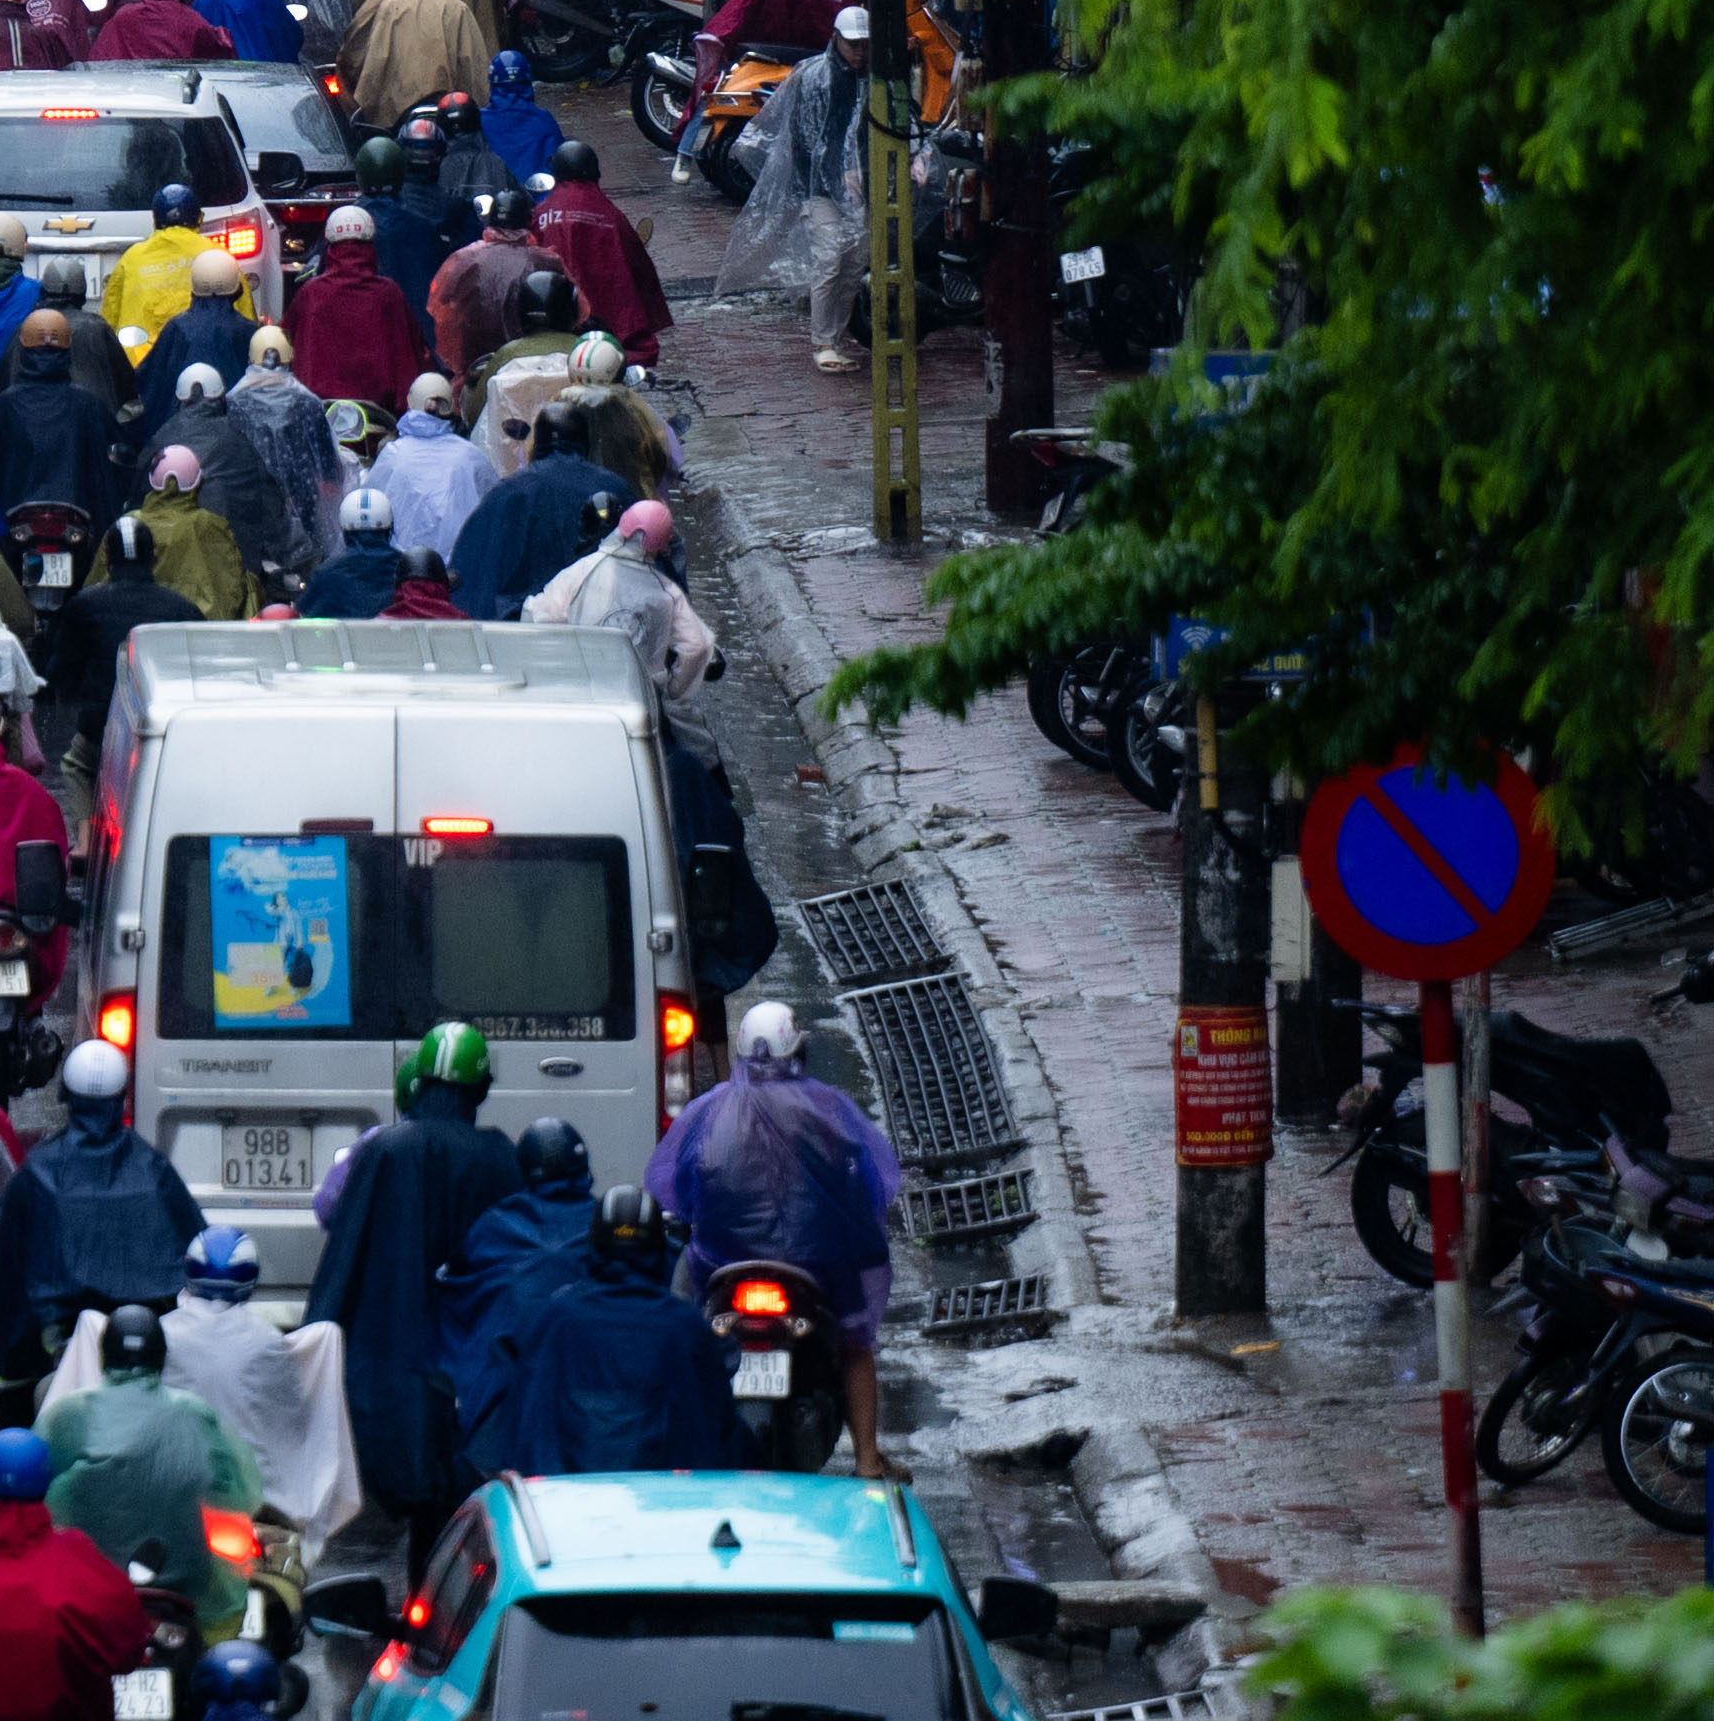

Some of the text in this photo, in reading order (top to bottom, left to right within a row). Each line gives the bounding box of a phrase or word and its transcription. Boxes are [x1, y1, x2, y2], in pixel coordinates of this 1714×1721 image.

[538, 210, 563, 229] giz
[403, 838, 444, 868] VIP
[179, 1058, 273, 1074] TRANSIT
[245, 1129, 291, 1156] 98B
[225, 1158, 309, 1188] 013.41
